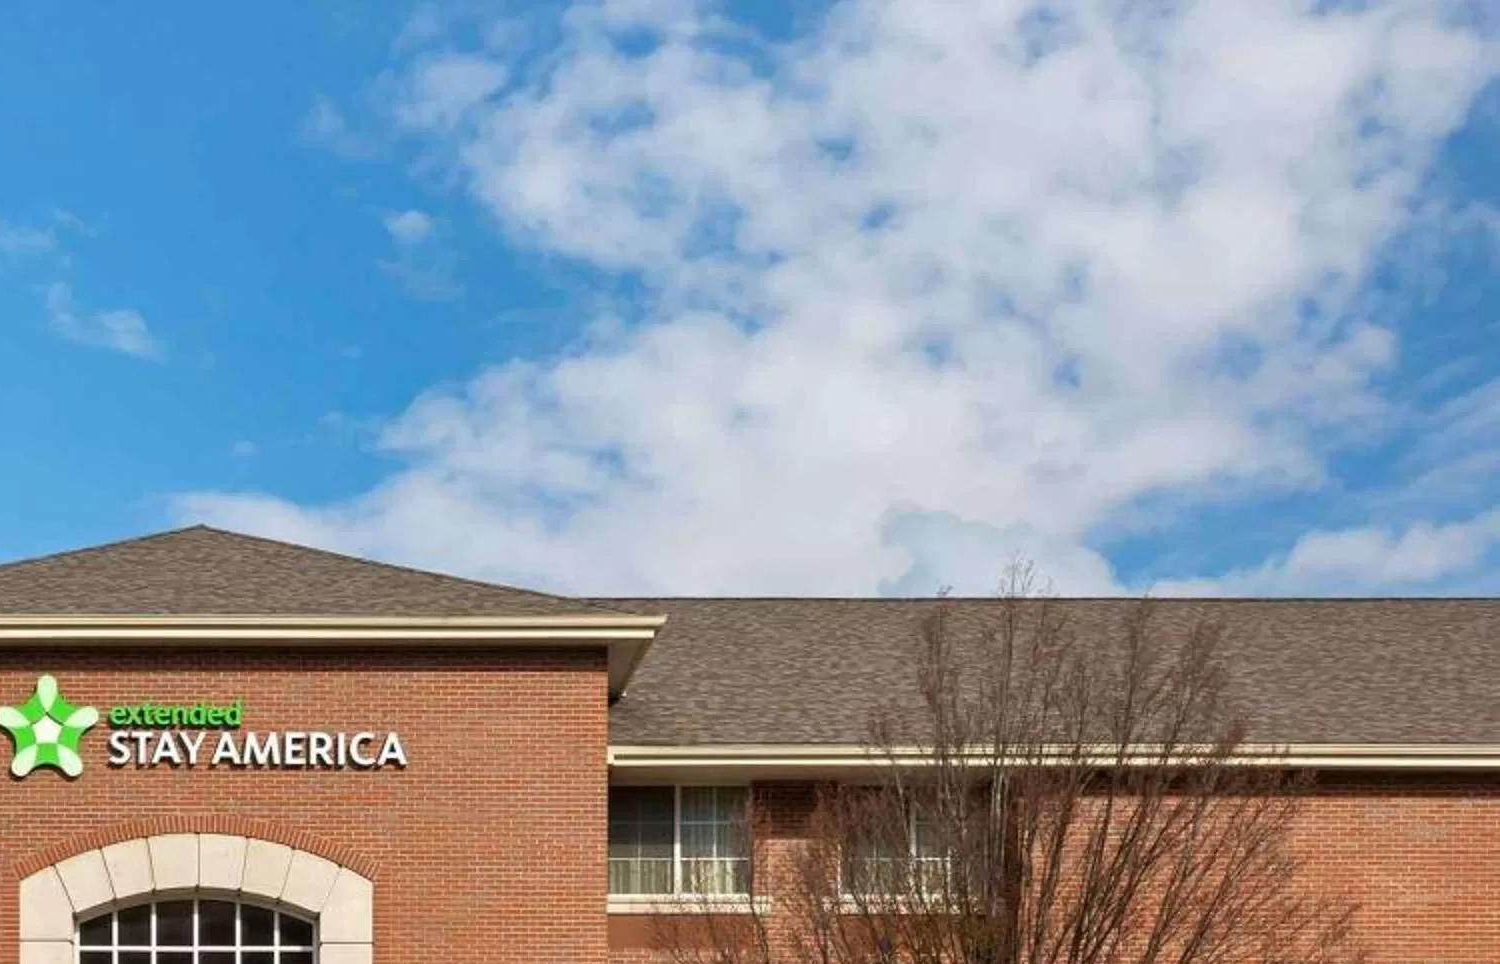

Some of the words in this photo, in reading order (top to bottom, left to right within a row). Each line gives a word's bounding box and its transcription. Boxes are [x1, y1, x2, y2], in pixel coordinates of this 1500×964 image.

[109, 697, 242, 726] extended
[108, 731, 204, 766] STAY
[211, 731, 408, 766] AMERICA
